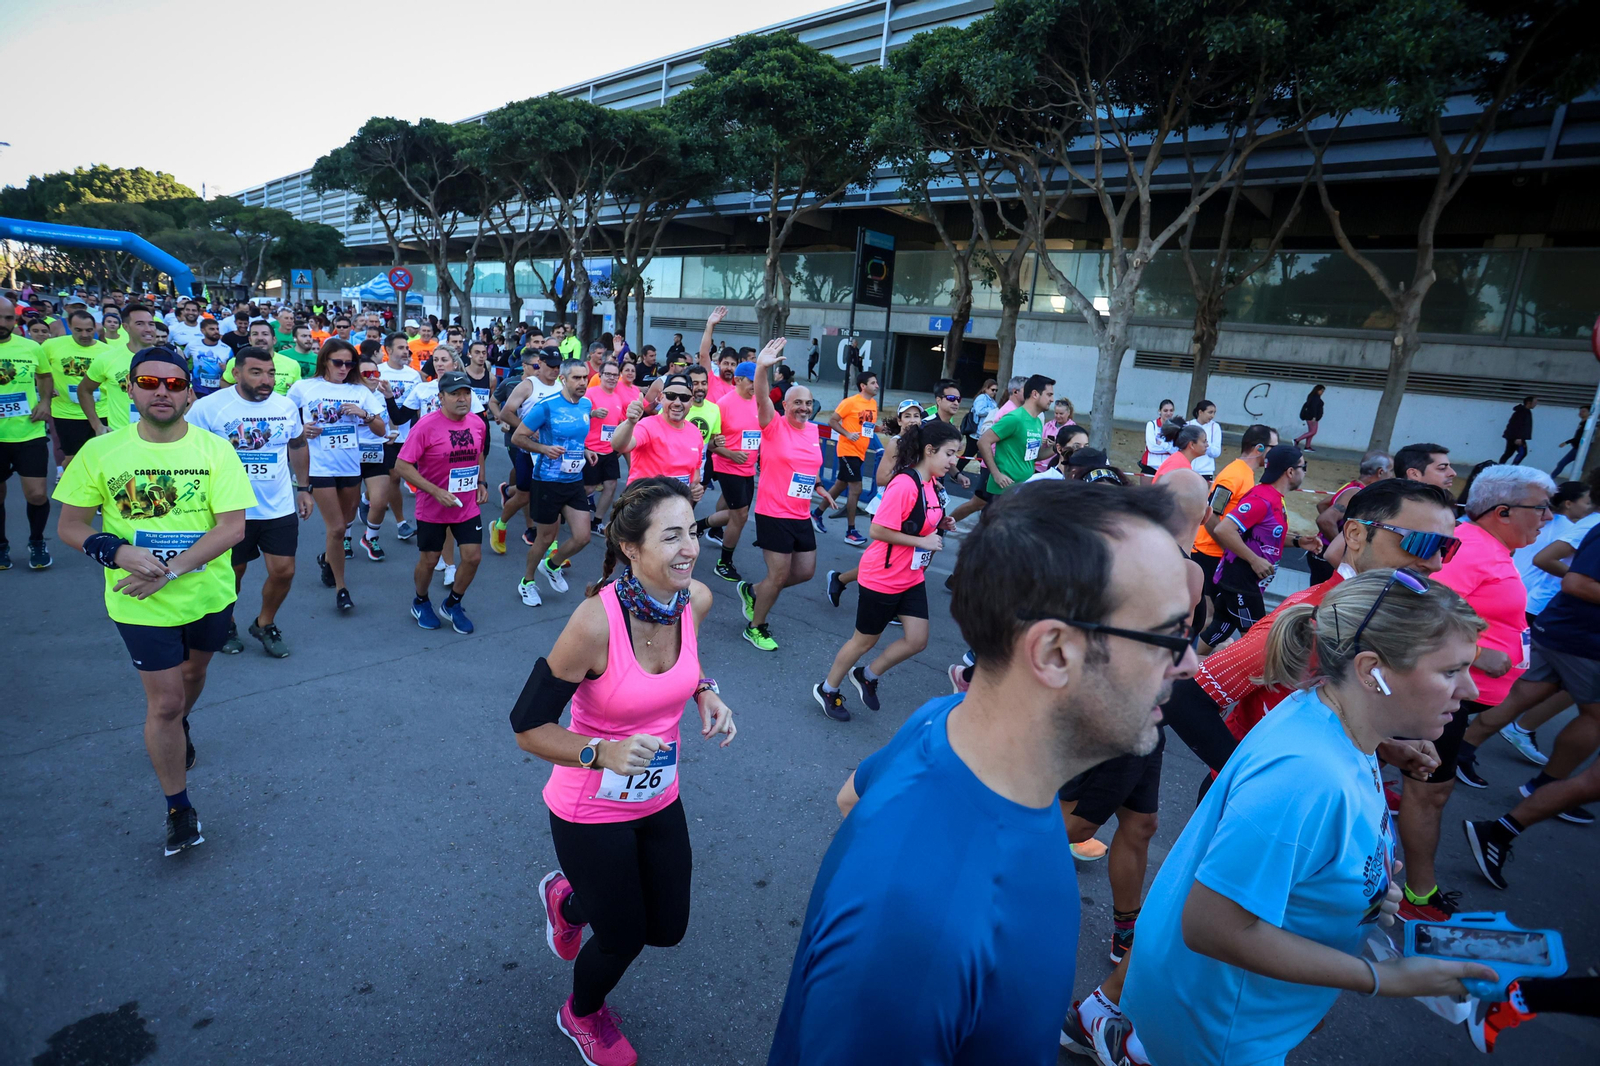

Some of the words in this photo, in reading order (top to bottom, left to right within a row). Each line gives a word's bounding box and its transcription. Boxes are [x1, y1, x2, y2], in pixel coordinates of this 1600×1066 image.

[934, 319, 942, 330] 4
[840, 328, 860, 337] Tribna
[329, 434, 349, 445] 315
[747, 438, 759, 446] 511
[362, 451, 378, 460] 665
[449, 448, 478, 457] ANIMALS
[448, 455, 477, 464] RUNNING
[243, 463, 268, 475] 135
[570, 460, 580, 469] 67
[173, 468, 210, 476] POPULAR
[457, 477, 474, 487] 134
[796, 483, 812, 494] 356
[152, 549, 187, 564] 58
[625, 768, 664, 790] 126
